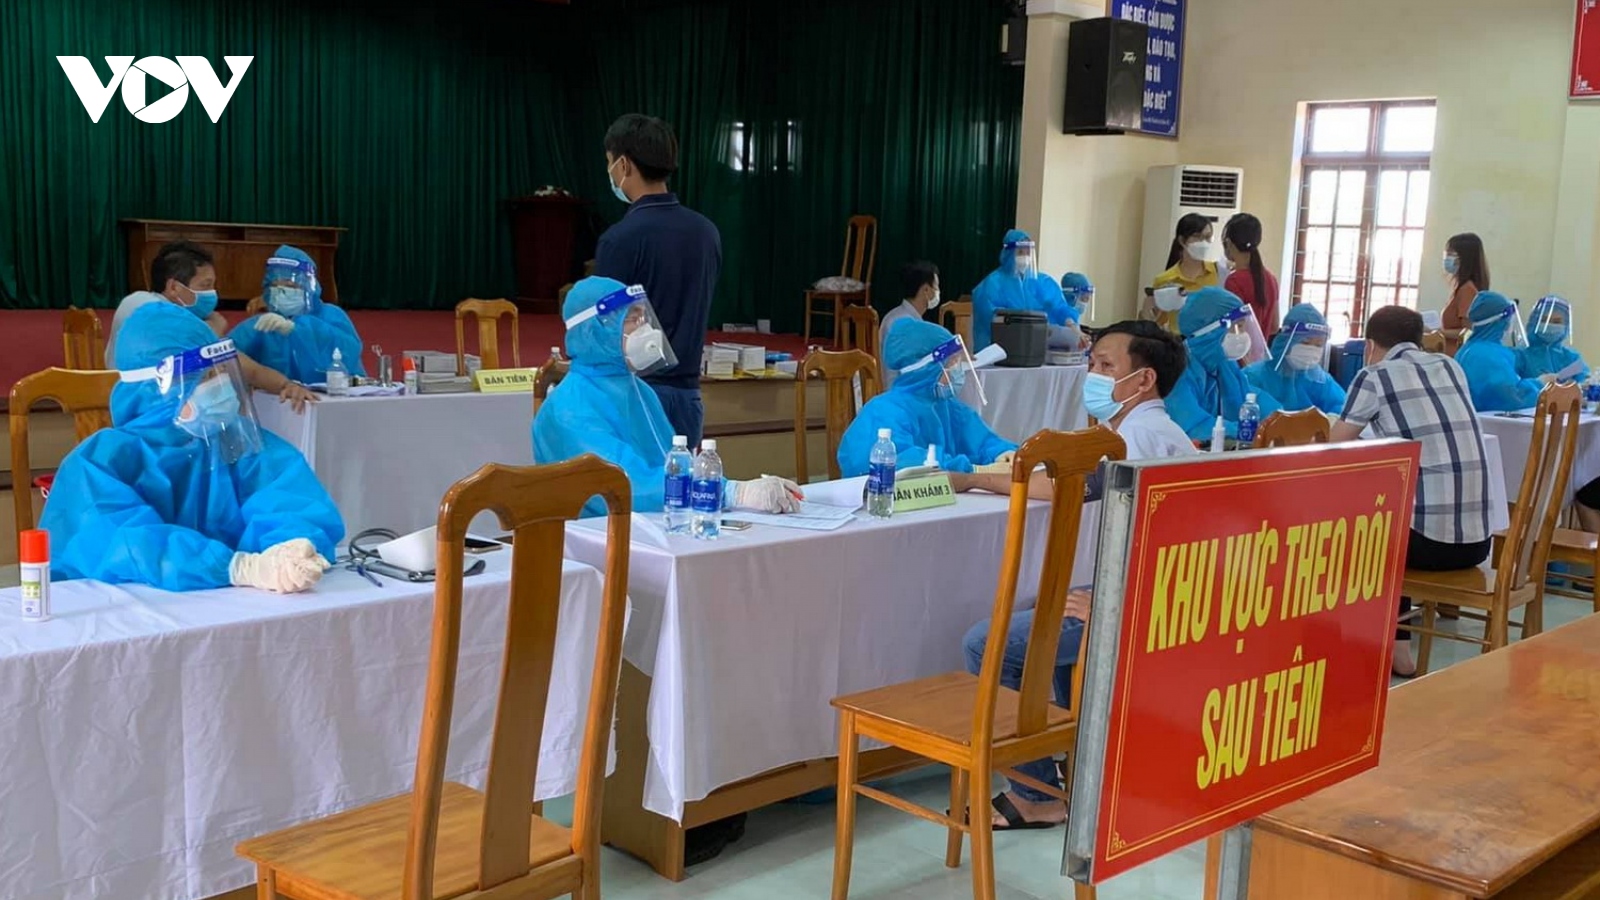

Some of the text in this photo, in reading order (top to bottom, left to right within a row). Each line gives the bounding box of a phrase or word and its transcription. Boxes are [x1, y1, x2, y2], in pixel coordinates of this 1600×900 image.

[913, 483, 944, 499] KHÁM
[944, 484, 951, 495] 3
[1147, 494, 1393, 654] KHU VỰC THEO DÕI
[1197, 645, 1327, 790] SAU TIÊM
